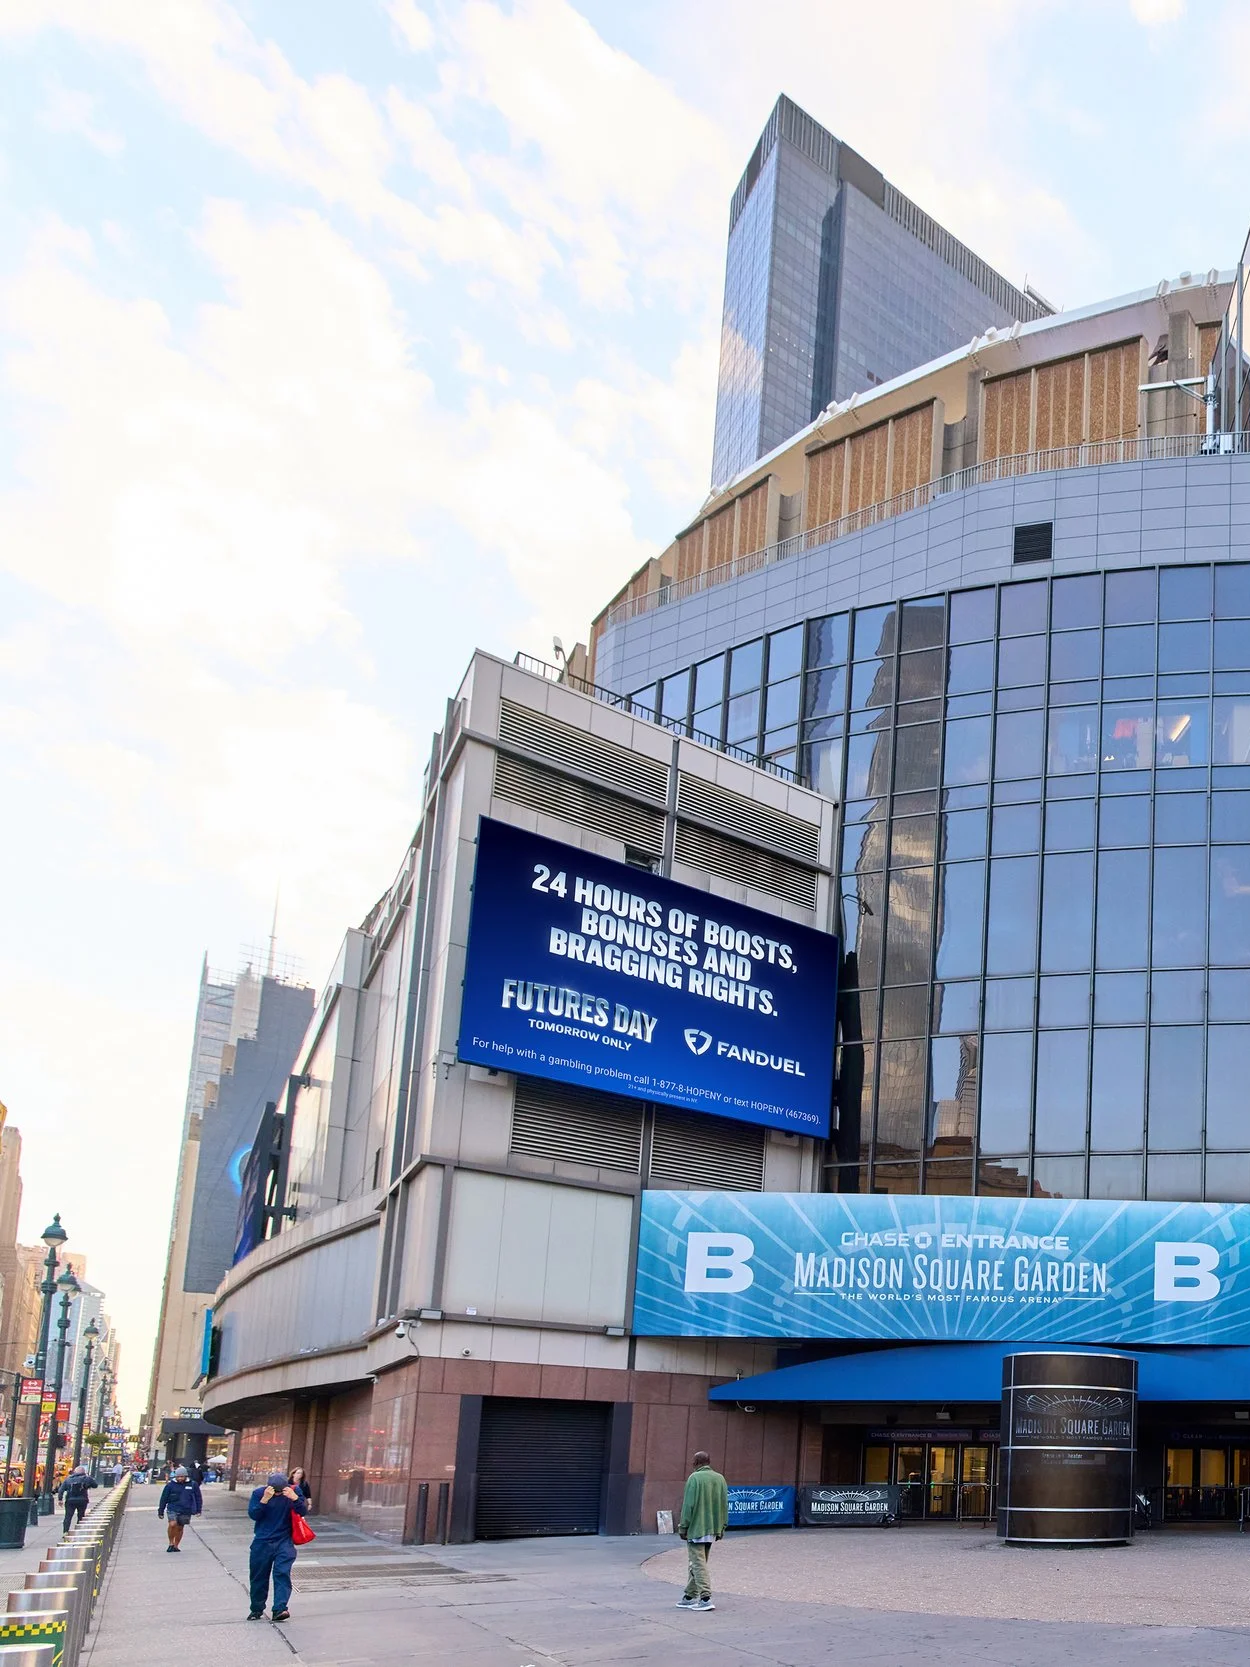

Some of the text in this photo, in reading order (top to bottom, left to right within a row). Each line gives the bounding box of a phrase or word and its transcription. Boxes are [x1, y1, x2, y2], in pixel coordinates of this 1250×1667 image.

[532, 863, 798, 974] 24 HOURS OF BOOSTS,
[581, 907, 752, 982] BONUSES AND
[549, 926, 778, 1017] BRAGGING RIGHTS.
[501, 978, 658, 1043] FUTURES DAY
[528, 1018, 632, 1051] TOMORROW ONLY
[717, 1041, 806, 1077] FANDUEL
[473, 1036, 821, 1125] For help with a gambling problem call 1-877-8-HOPENY or text HOPENY (467369).
[841, 1232, 1070, 1250] CHASE ENTRANCE
[684, 1232, 755, 1293] B
[794, 1252, 903, 1289] MADISON
[912, 1253, 1004, 1292] SQUARE
[1154, 1241, 1221, 1302] B
[868, 1293, 922, 1301] WORLD'S
[928, 1294, 960, 1302] MOST
[966, 1295, 1014, 1303] FAMOUS
[1015, 1417, 1056, 1434] MADISON
[1060, 1416, 1099, 1436] SQUARE
[735, 1500, 758, 1512] SQUARE
[760, 1500, 783, 1511] GARDEN
[811, 1501, 888, 1512] MADISON SQUARE GARDEN
